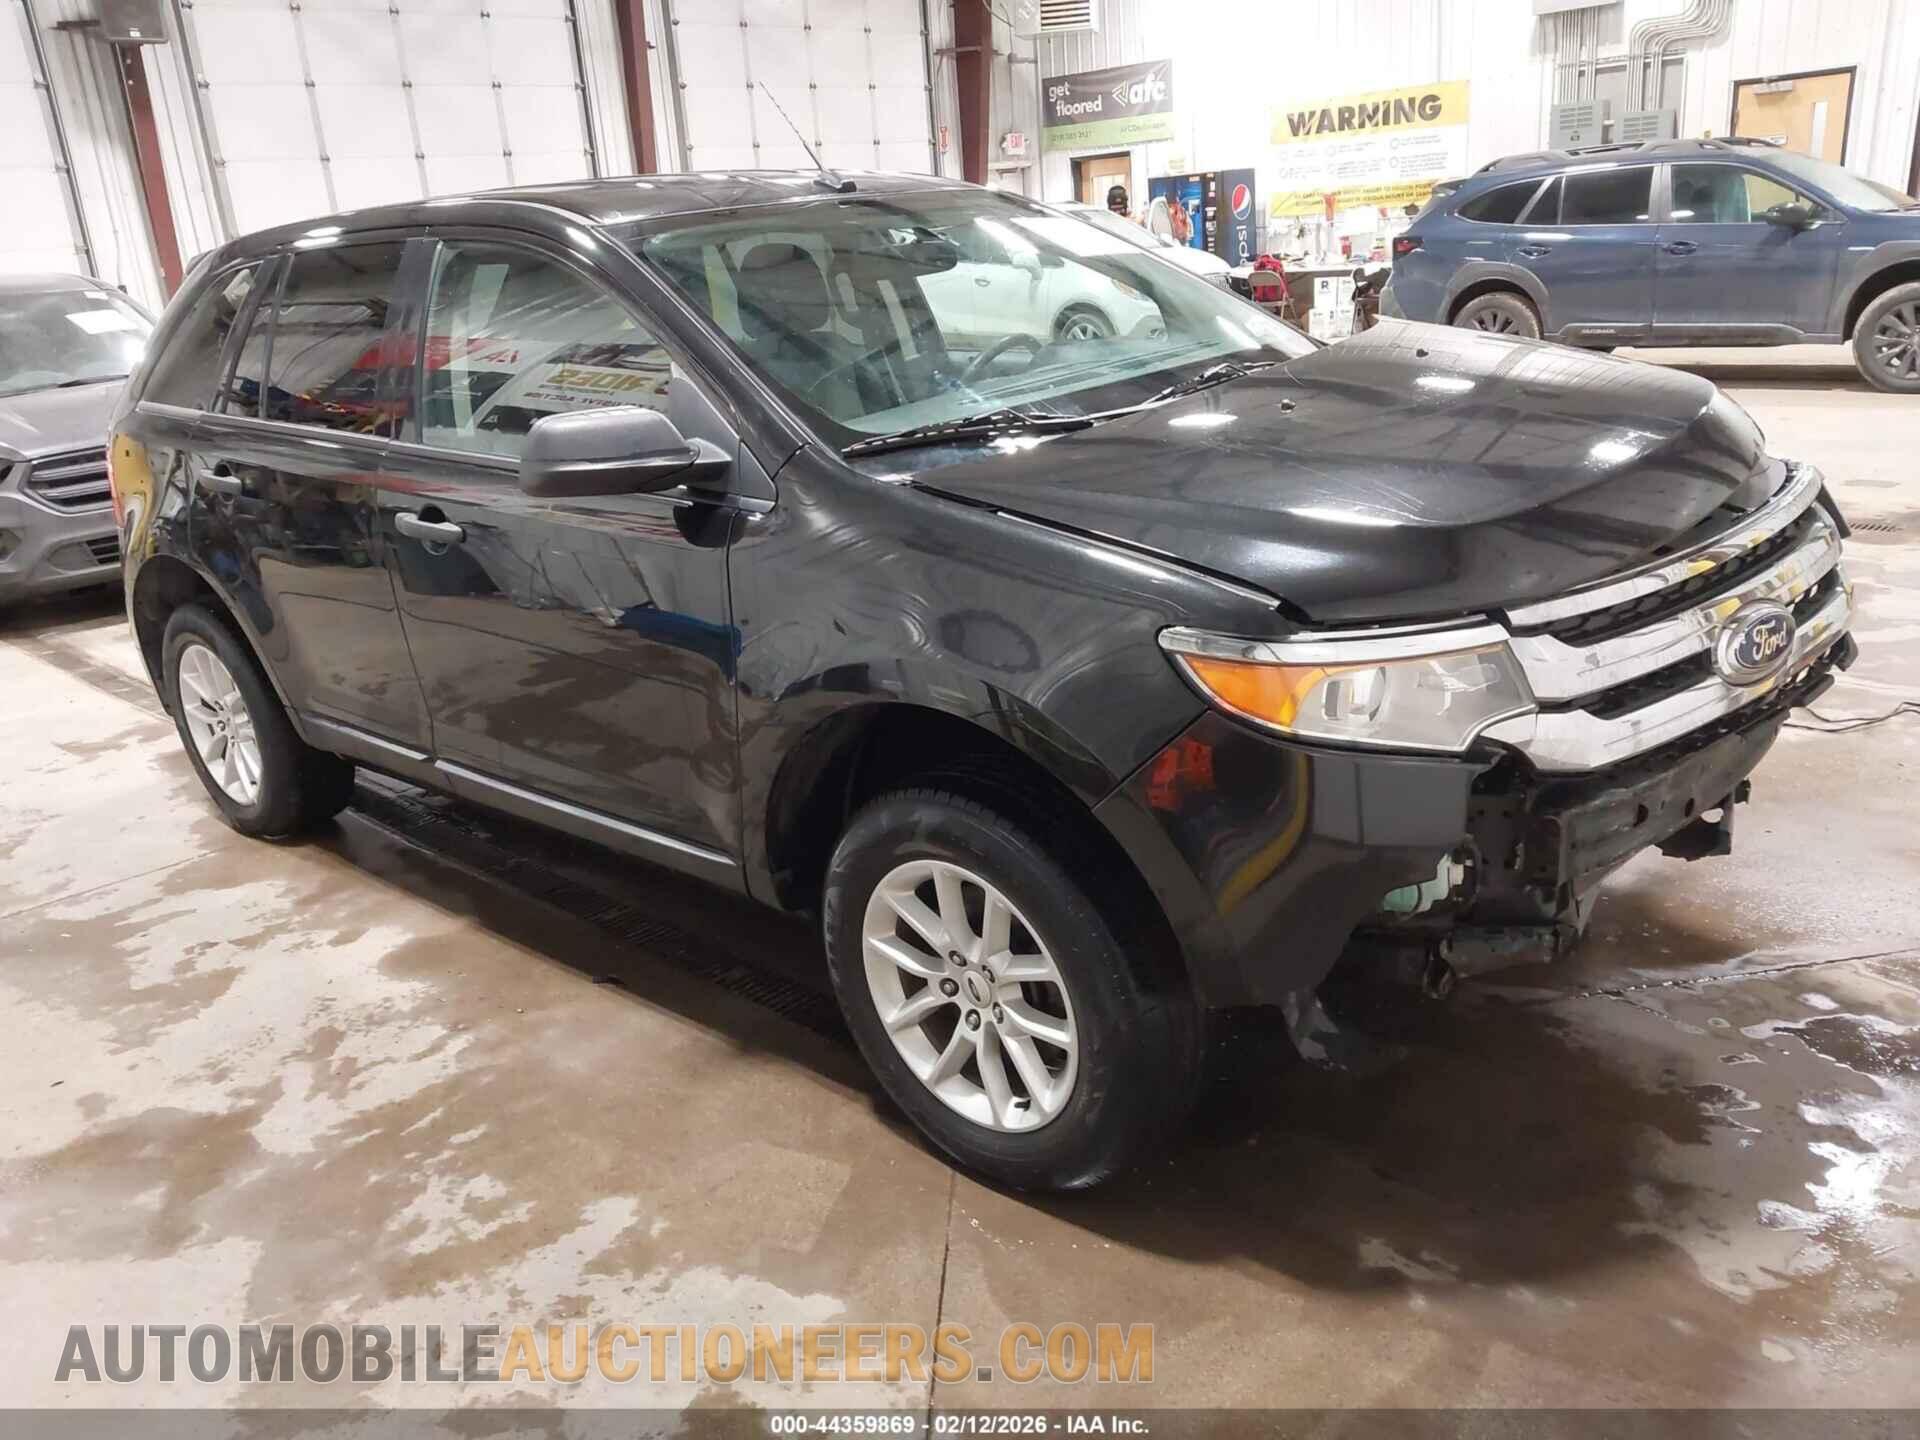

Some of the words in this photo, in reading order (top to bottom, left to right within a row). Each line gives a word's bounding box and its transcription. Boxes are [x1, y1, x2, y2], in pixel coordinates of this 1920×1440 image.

[1049, 82, 1070, 101] get
[1129, 72, 1166, 104] afc
[1056, 94, 1103, 116] floored
[1287, 94, 1442, 137] WARNING
[1752, 619, 1787, 661] Ford
